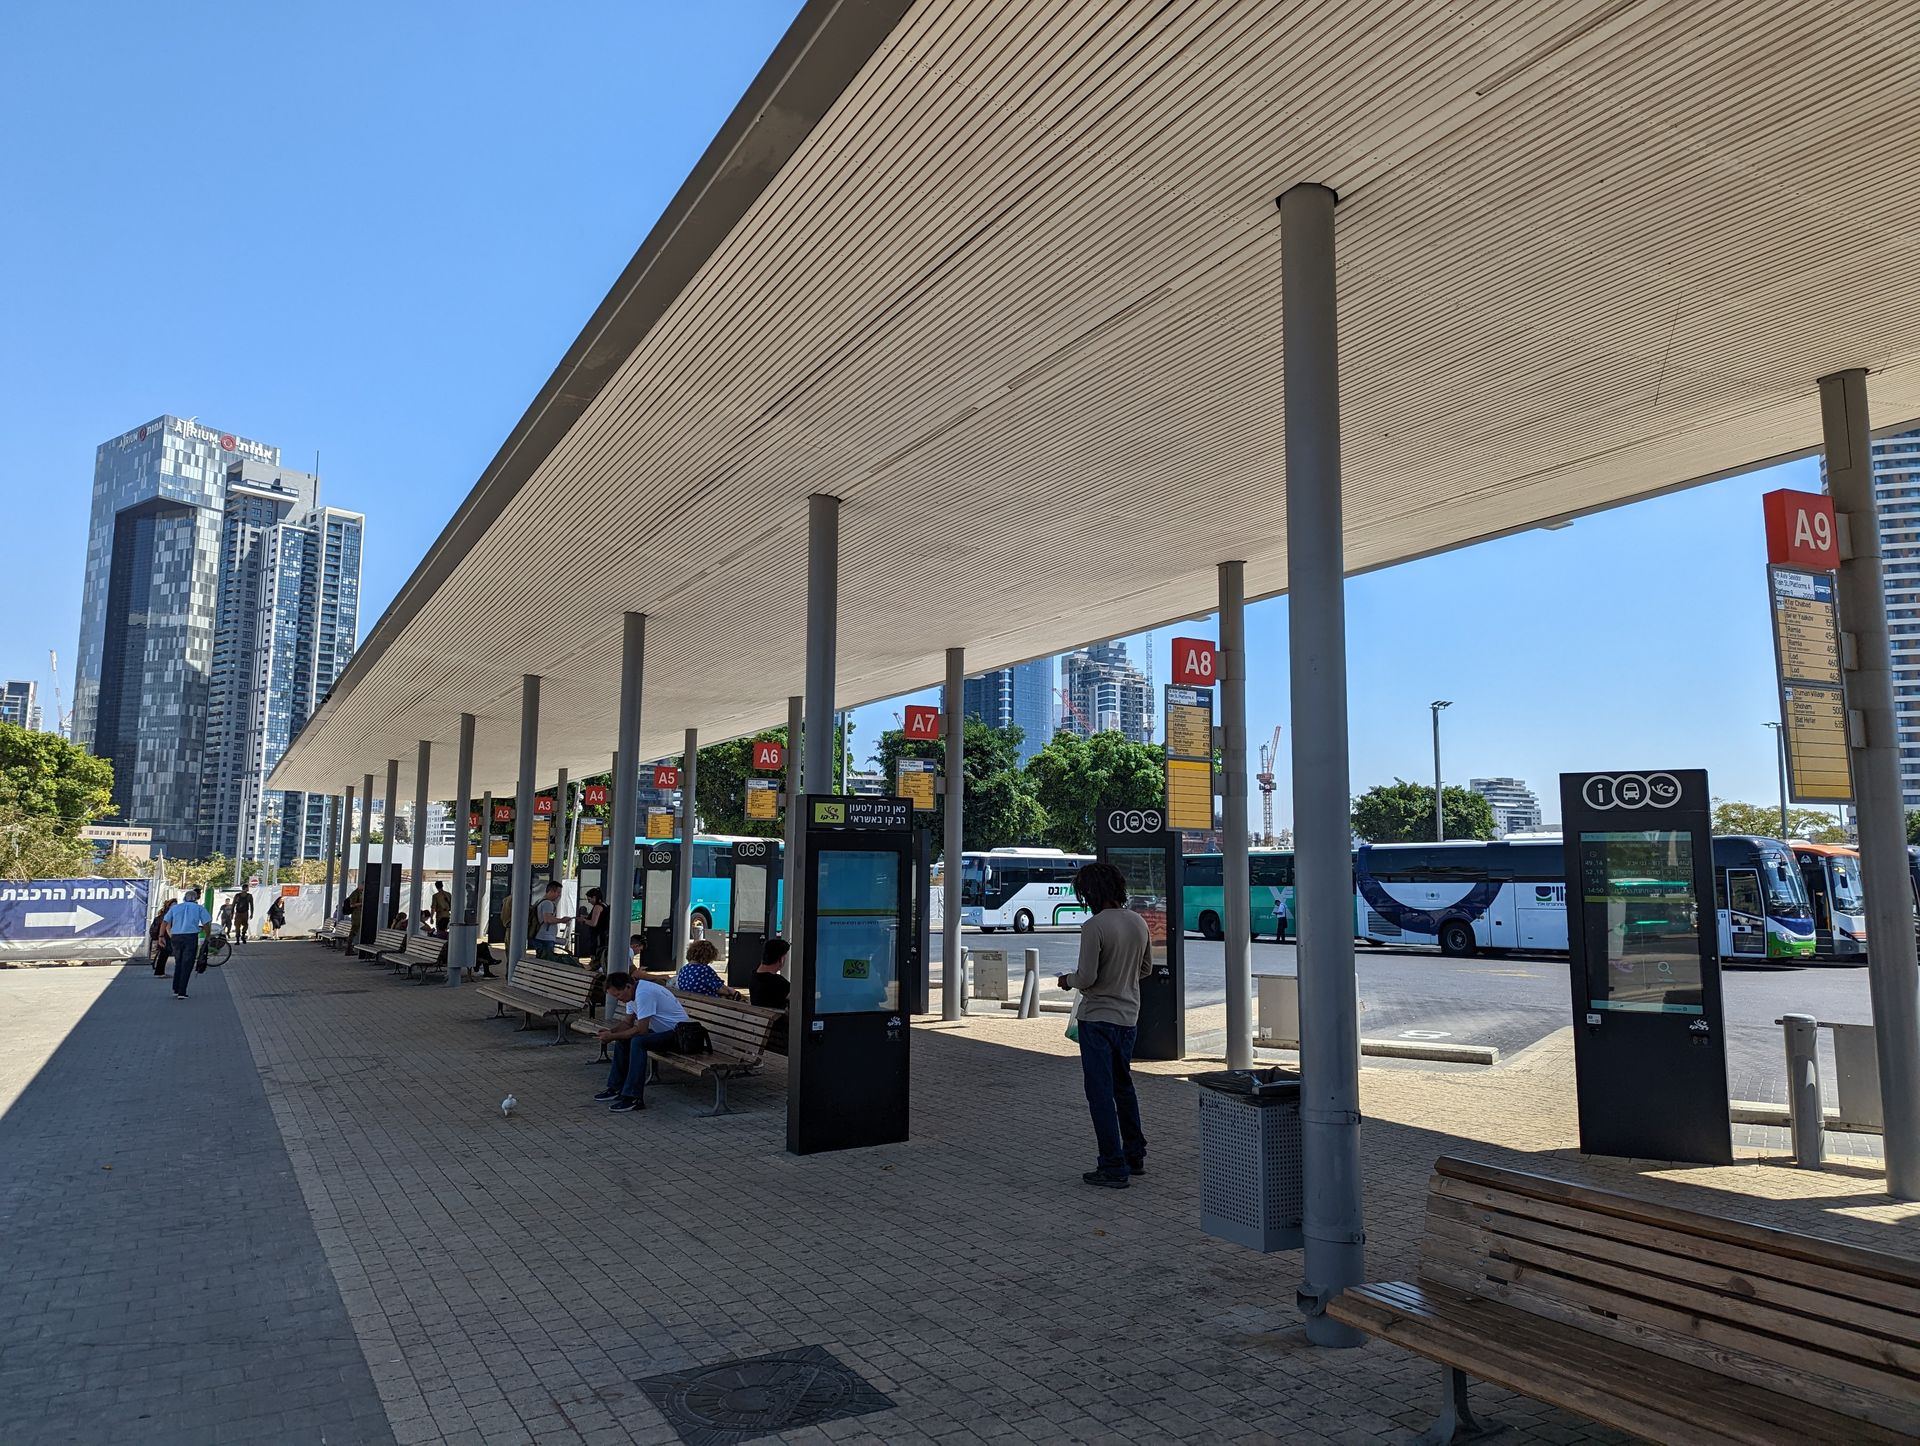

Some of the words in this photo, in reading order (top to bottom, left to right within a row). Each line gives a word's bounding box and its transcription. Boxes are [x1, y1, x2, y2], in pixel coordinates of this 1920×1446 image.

[175, 419, 218, 445] ATRIUM
[1794, 508, 1831, 551] A9
[1795, 600, 1811, 608] Chabad
[1787, 625, 1801, 634] Ramla
[1788, 639, 1803, 647] Ramla
[1185, 650, 1212, 676] A8
[1830, 672, 1840, 680] 462
[1831, 693, 1841, 701] 500
[1832, 706, 1842, 715] 500
[913, 714, 935, 732] A7
[760, 749, 778, 763] A6
[659, 773, 675, 784] A5
[589, 790, 604, 801] A4
[538, 801, 551, 810] A3
[849, 803, 873, 813] לטעון
[874, 805, 891, 815] ניתן
[892, 806, 906, 815] כאן
[497, 810, 509, 819] A2
[850, 815, 882, 824] באשראי
[885, 816, 895, 826] קו
[0, 887, 67, 901] הרכבת
[72, 886, 136, 901] לתחנת
